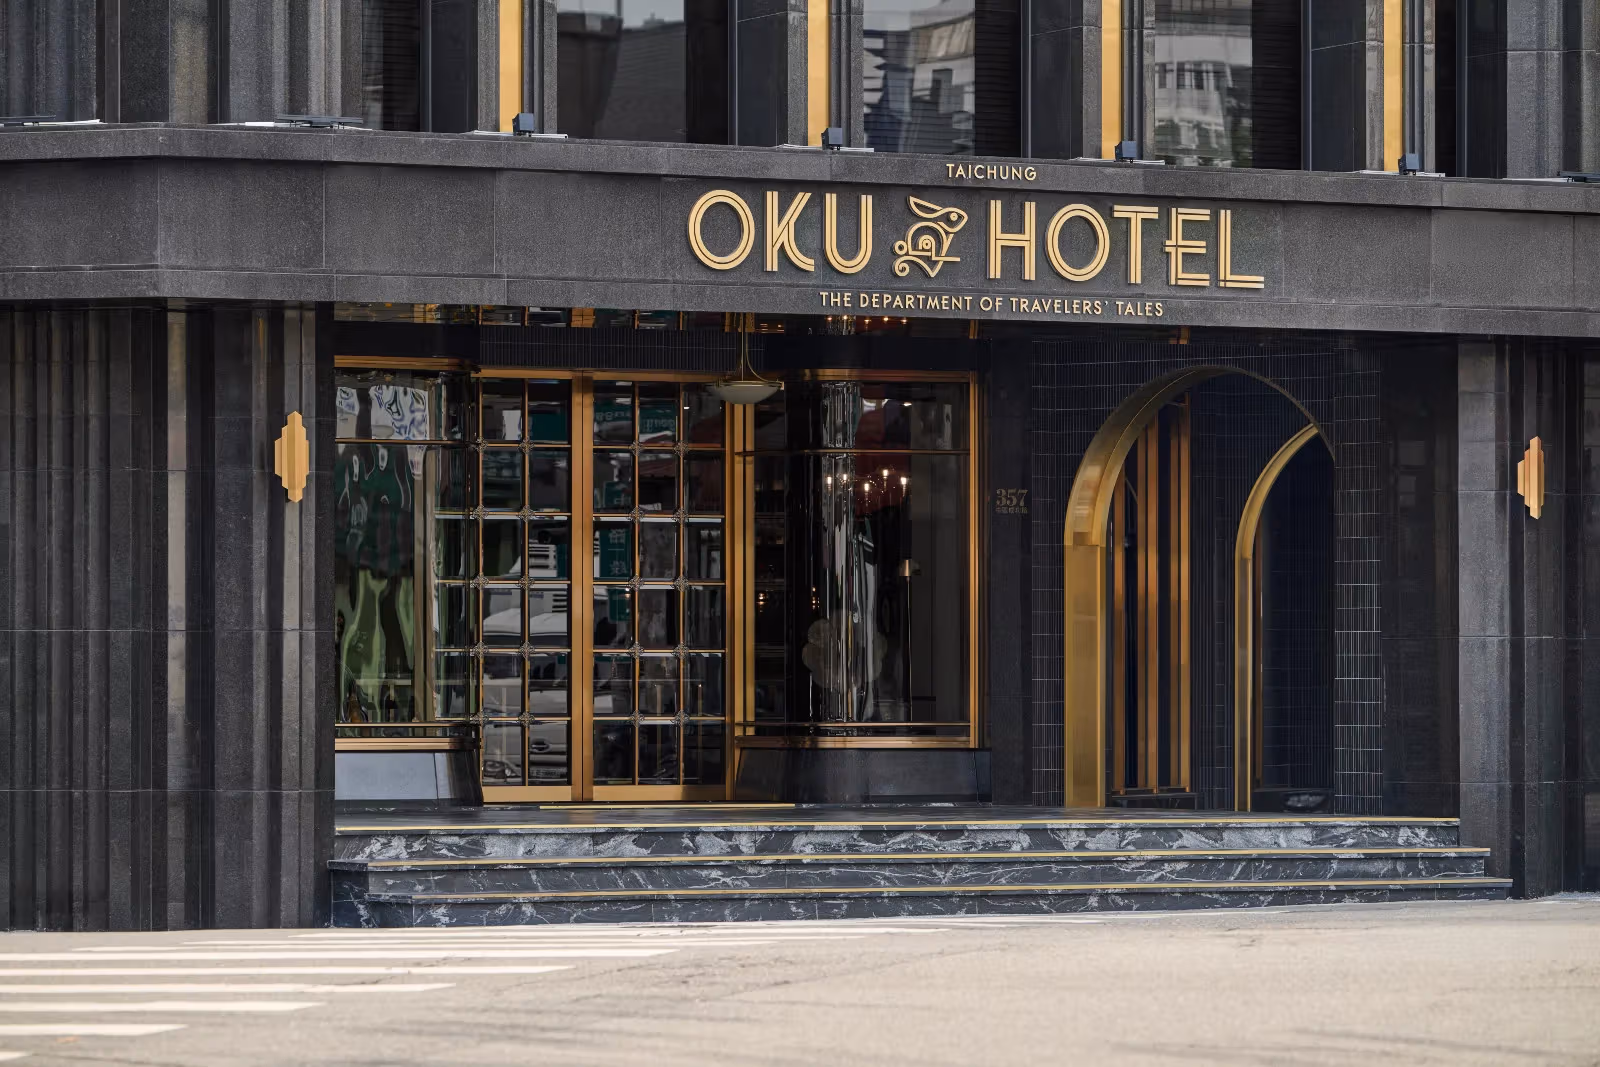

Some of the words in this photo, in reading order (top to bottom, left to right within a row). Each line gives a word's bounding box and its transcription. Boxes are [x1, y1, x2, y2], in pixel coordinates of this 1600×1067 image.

[945, 163, 1038, 182] TAICHUNG
[687, 189, 874, 275] OKU
[988, 199, 1266, 290] HOTEL
[820, 291, 852, 308] THE
[859, 292, 973, 311] DEPARTMENT
[979, 297, 1004, 311] OF
[1115, 301, 1164, 317] TALES
[996, 488, 1029, 507] 357
